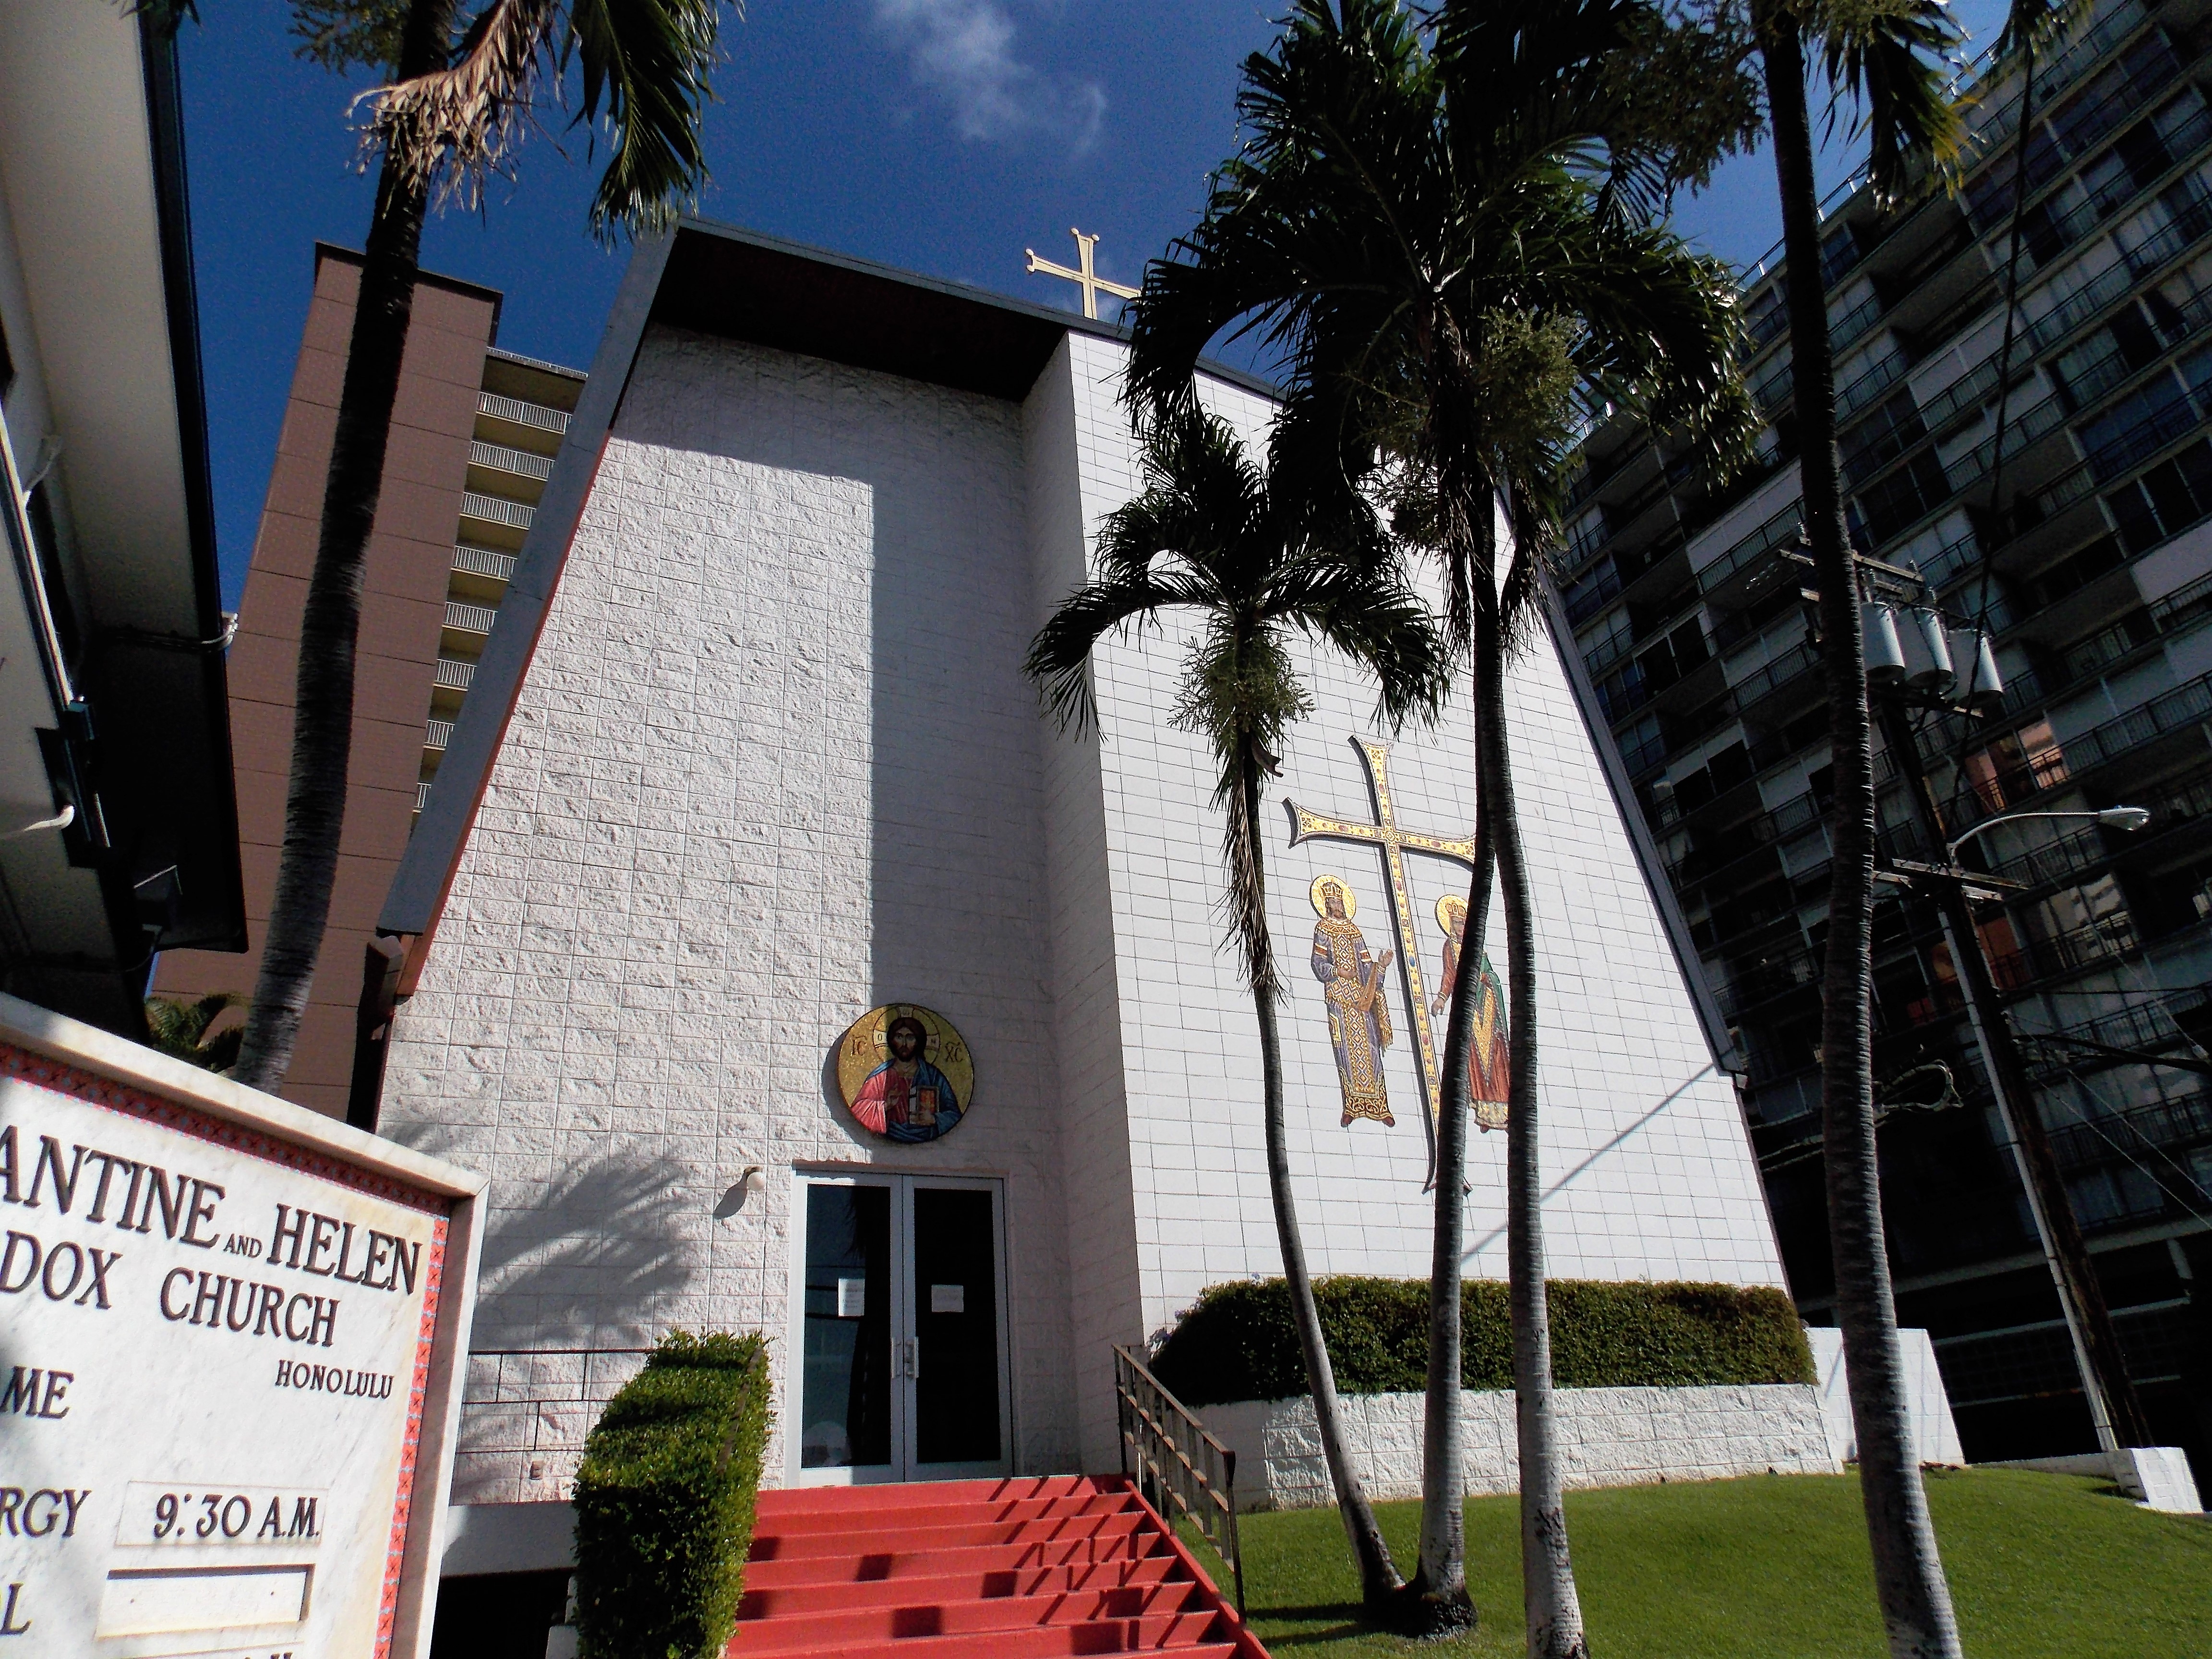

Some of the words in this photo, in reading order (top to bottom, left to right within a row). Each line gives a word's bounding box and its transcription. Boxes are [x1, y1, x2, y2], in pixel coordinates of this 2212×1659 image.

[223, 1233, 263, 1258] AND
[267, 1203, 423, 1295] HELEN
[0, 1229, 123, 1310] DOX
[160, 1266, 340, 1347] CHURCH
[1, 1366, 74, 1419] ME
[275, 1359, 394, 1399] HONOLULU
[154, 1493, 252, 1538] 9:30
